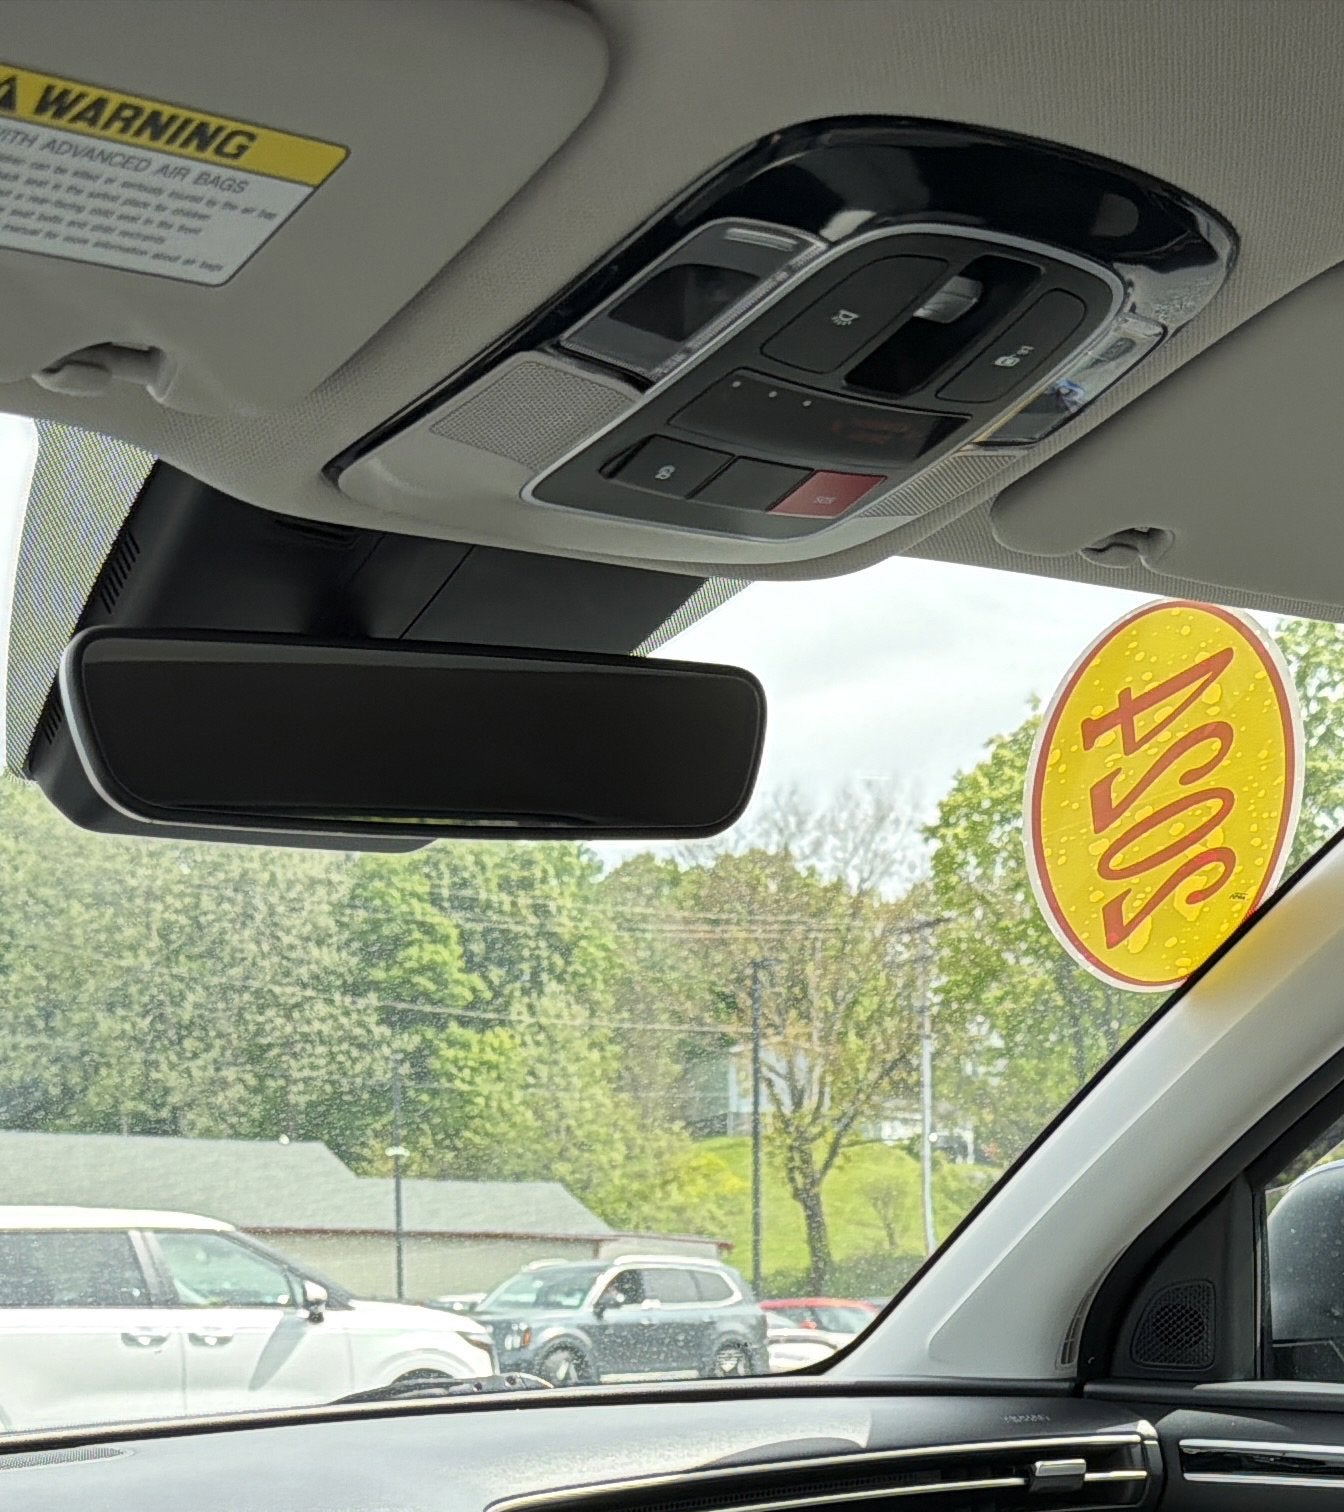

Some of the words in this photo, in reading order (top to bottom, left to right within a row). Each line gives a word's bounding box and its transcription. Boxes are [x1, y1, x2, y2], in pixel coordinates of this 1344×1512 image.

[34, 84, 257, 160] WARNING
[40, 138, 152, 173] ADVANCED
[155, 163, 191, 181] AIR
[193, 172, 250, 194] BAGS
